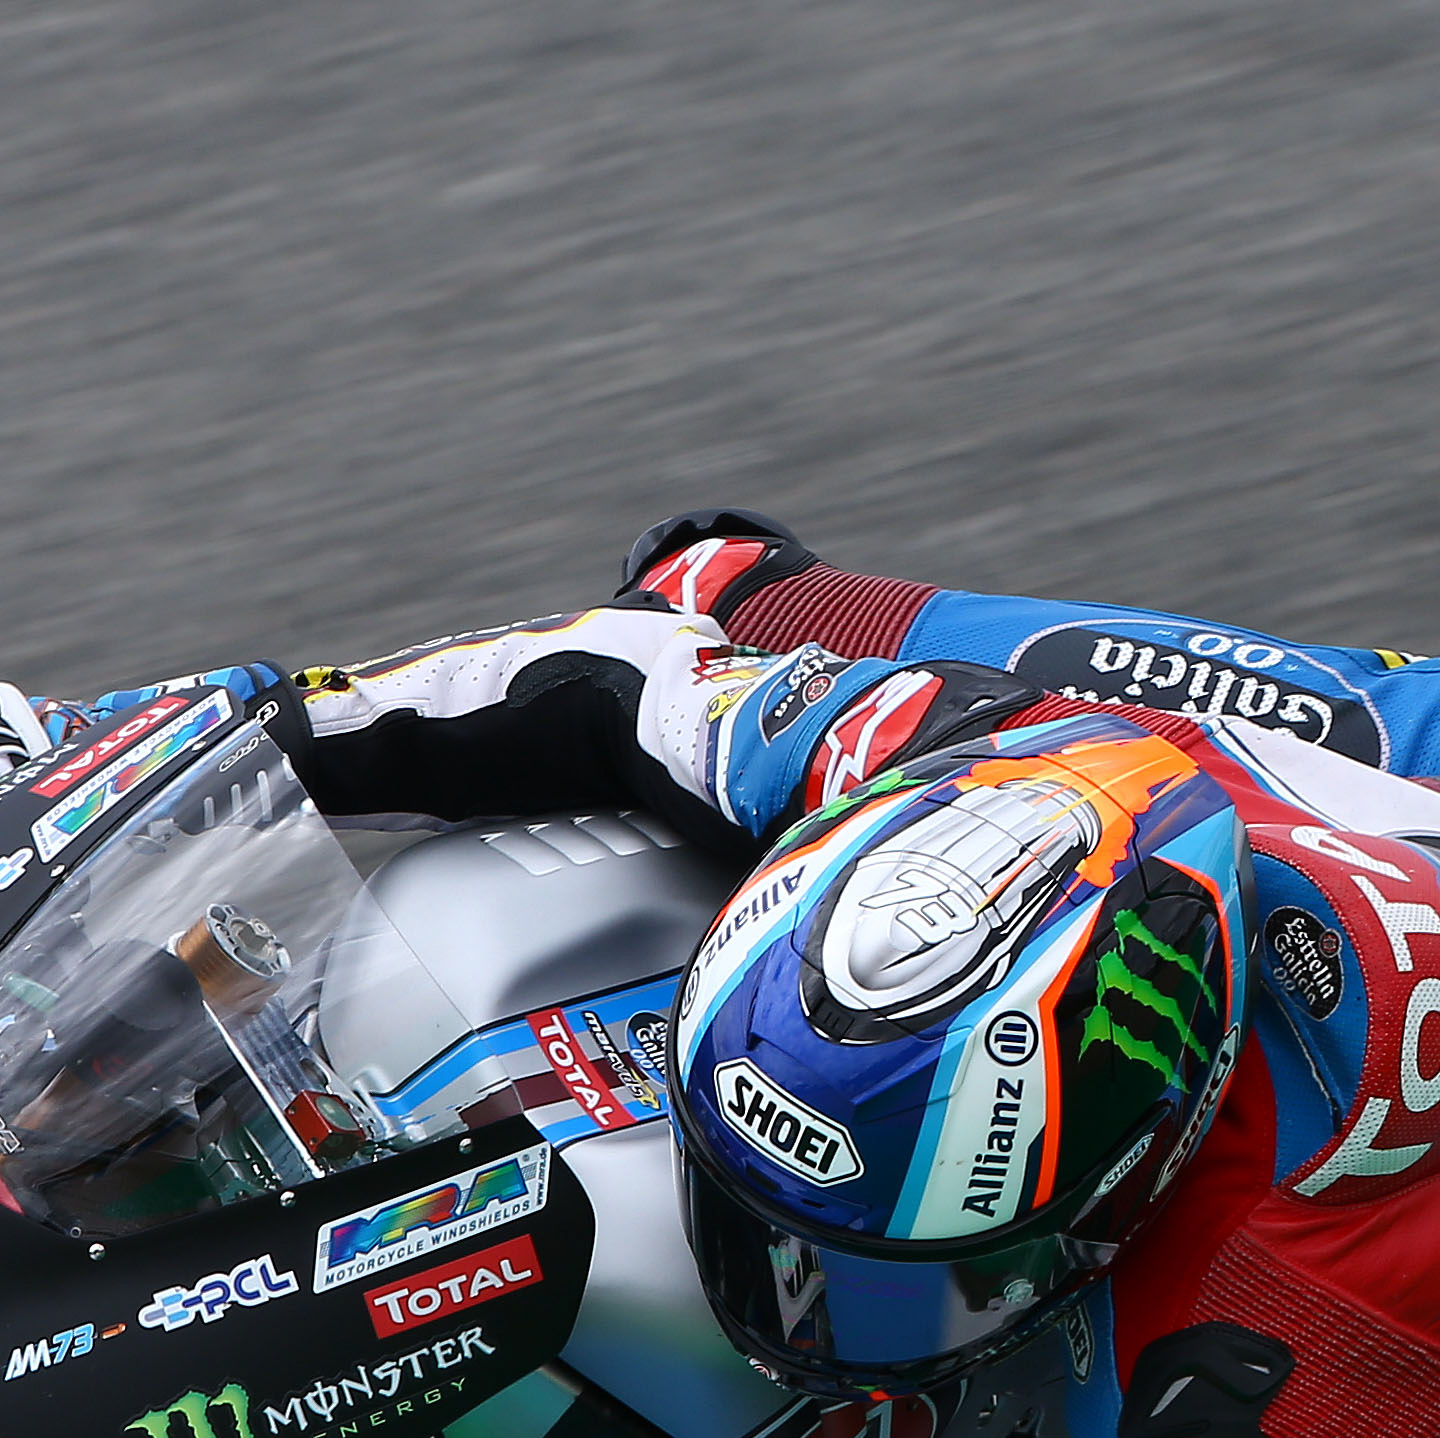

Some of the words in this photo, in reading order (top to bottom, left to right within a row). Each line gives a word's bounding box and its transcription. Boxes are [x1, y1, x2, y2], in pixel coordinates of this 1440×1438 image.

[1089, 637, 1334, 746] Galicia
[39, 699, 180, 790] TOTAL
[50, 702, 222, 835] MRA
[705, 863, 807, 970] Allianz
[859, 869, 979, 945] 73
[1274, 932, 1317, 1006] Galicia
[1285, 917, 1335, 1000] Estrella
[539, 1014, 616, 1126] TOTAL
[728, 1074, 840, 1176] SHOEI
[961, 1076, 1025, 1219] Allianz
[1104, 1136, 1153, 1187] SHOEI
[324, 1239, 425, 1286] MOTORCYCLE
[430, 1199, 531, 1247] WINDSHIELDS
[327, 1158, 529, 1270] MRA
[374, 1259, 533, 1324] TOTAL
